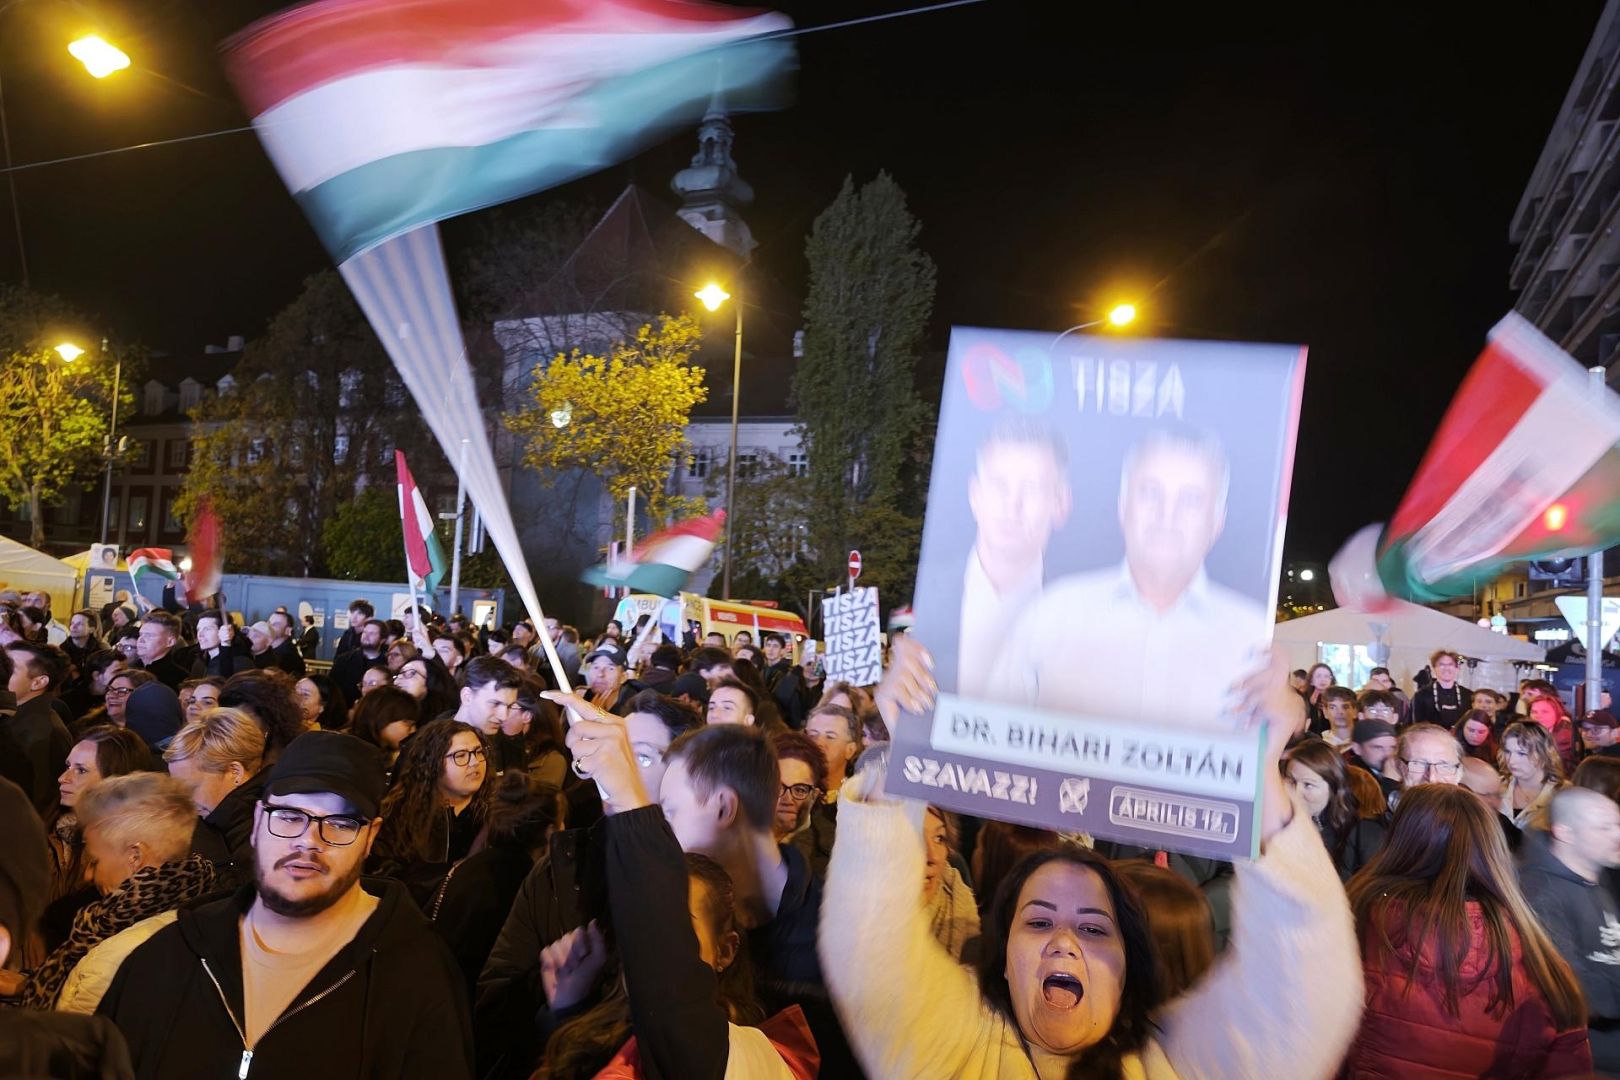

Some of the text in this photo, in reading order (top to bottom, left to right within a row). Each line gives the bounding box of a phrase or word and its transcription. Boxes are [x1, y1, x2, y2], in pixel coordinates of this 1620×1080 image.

[1070, 356, 1185, 419] TISZA
[822, 587, 879, 617] TISZA
[824, 605, 880, 637] TISZA
[824, 624, 880, 655] TISZA
[825, 642, 881, 674] TISZA
[952, 713, 1242, 782] DR. BIHARI ZOLTÁN
[903, 755, 1037, 806] SZAVAZZ!
[1119, 793, 1196, 827] ÁPRILIS
